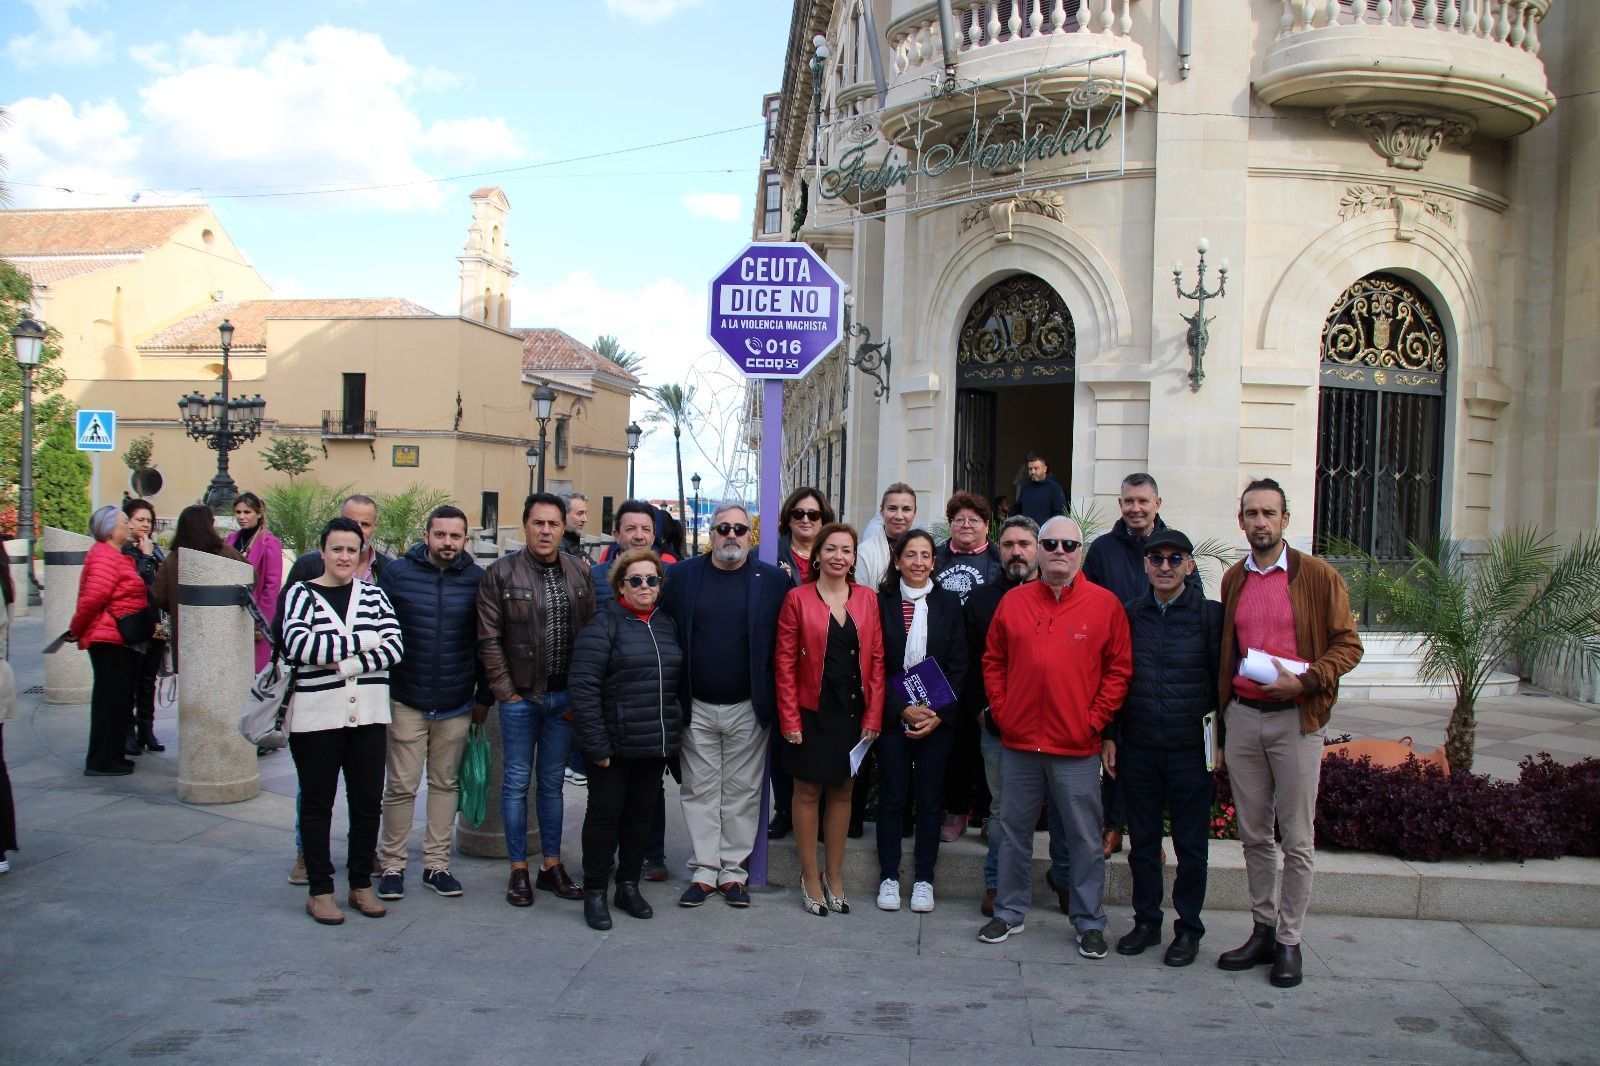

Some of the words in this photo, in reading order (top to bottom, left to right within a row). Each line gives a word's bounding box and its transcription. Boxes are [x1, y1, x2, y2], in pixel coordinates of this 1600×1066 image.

[923, 101, 1121, 177] Navidad
[740, 256, 811, 283] CEUTA
[731, 288, 782, 313] DICE
[790, 289, 819, 314] NO
[720, 319, 727, 329] A
[728, 319, 738, 329] LA
[740, 319, 784, 330] VIOLENCIA
[785, 320, 828, 331] MACHISTA
[765, 338, 802, 355] 016
